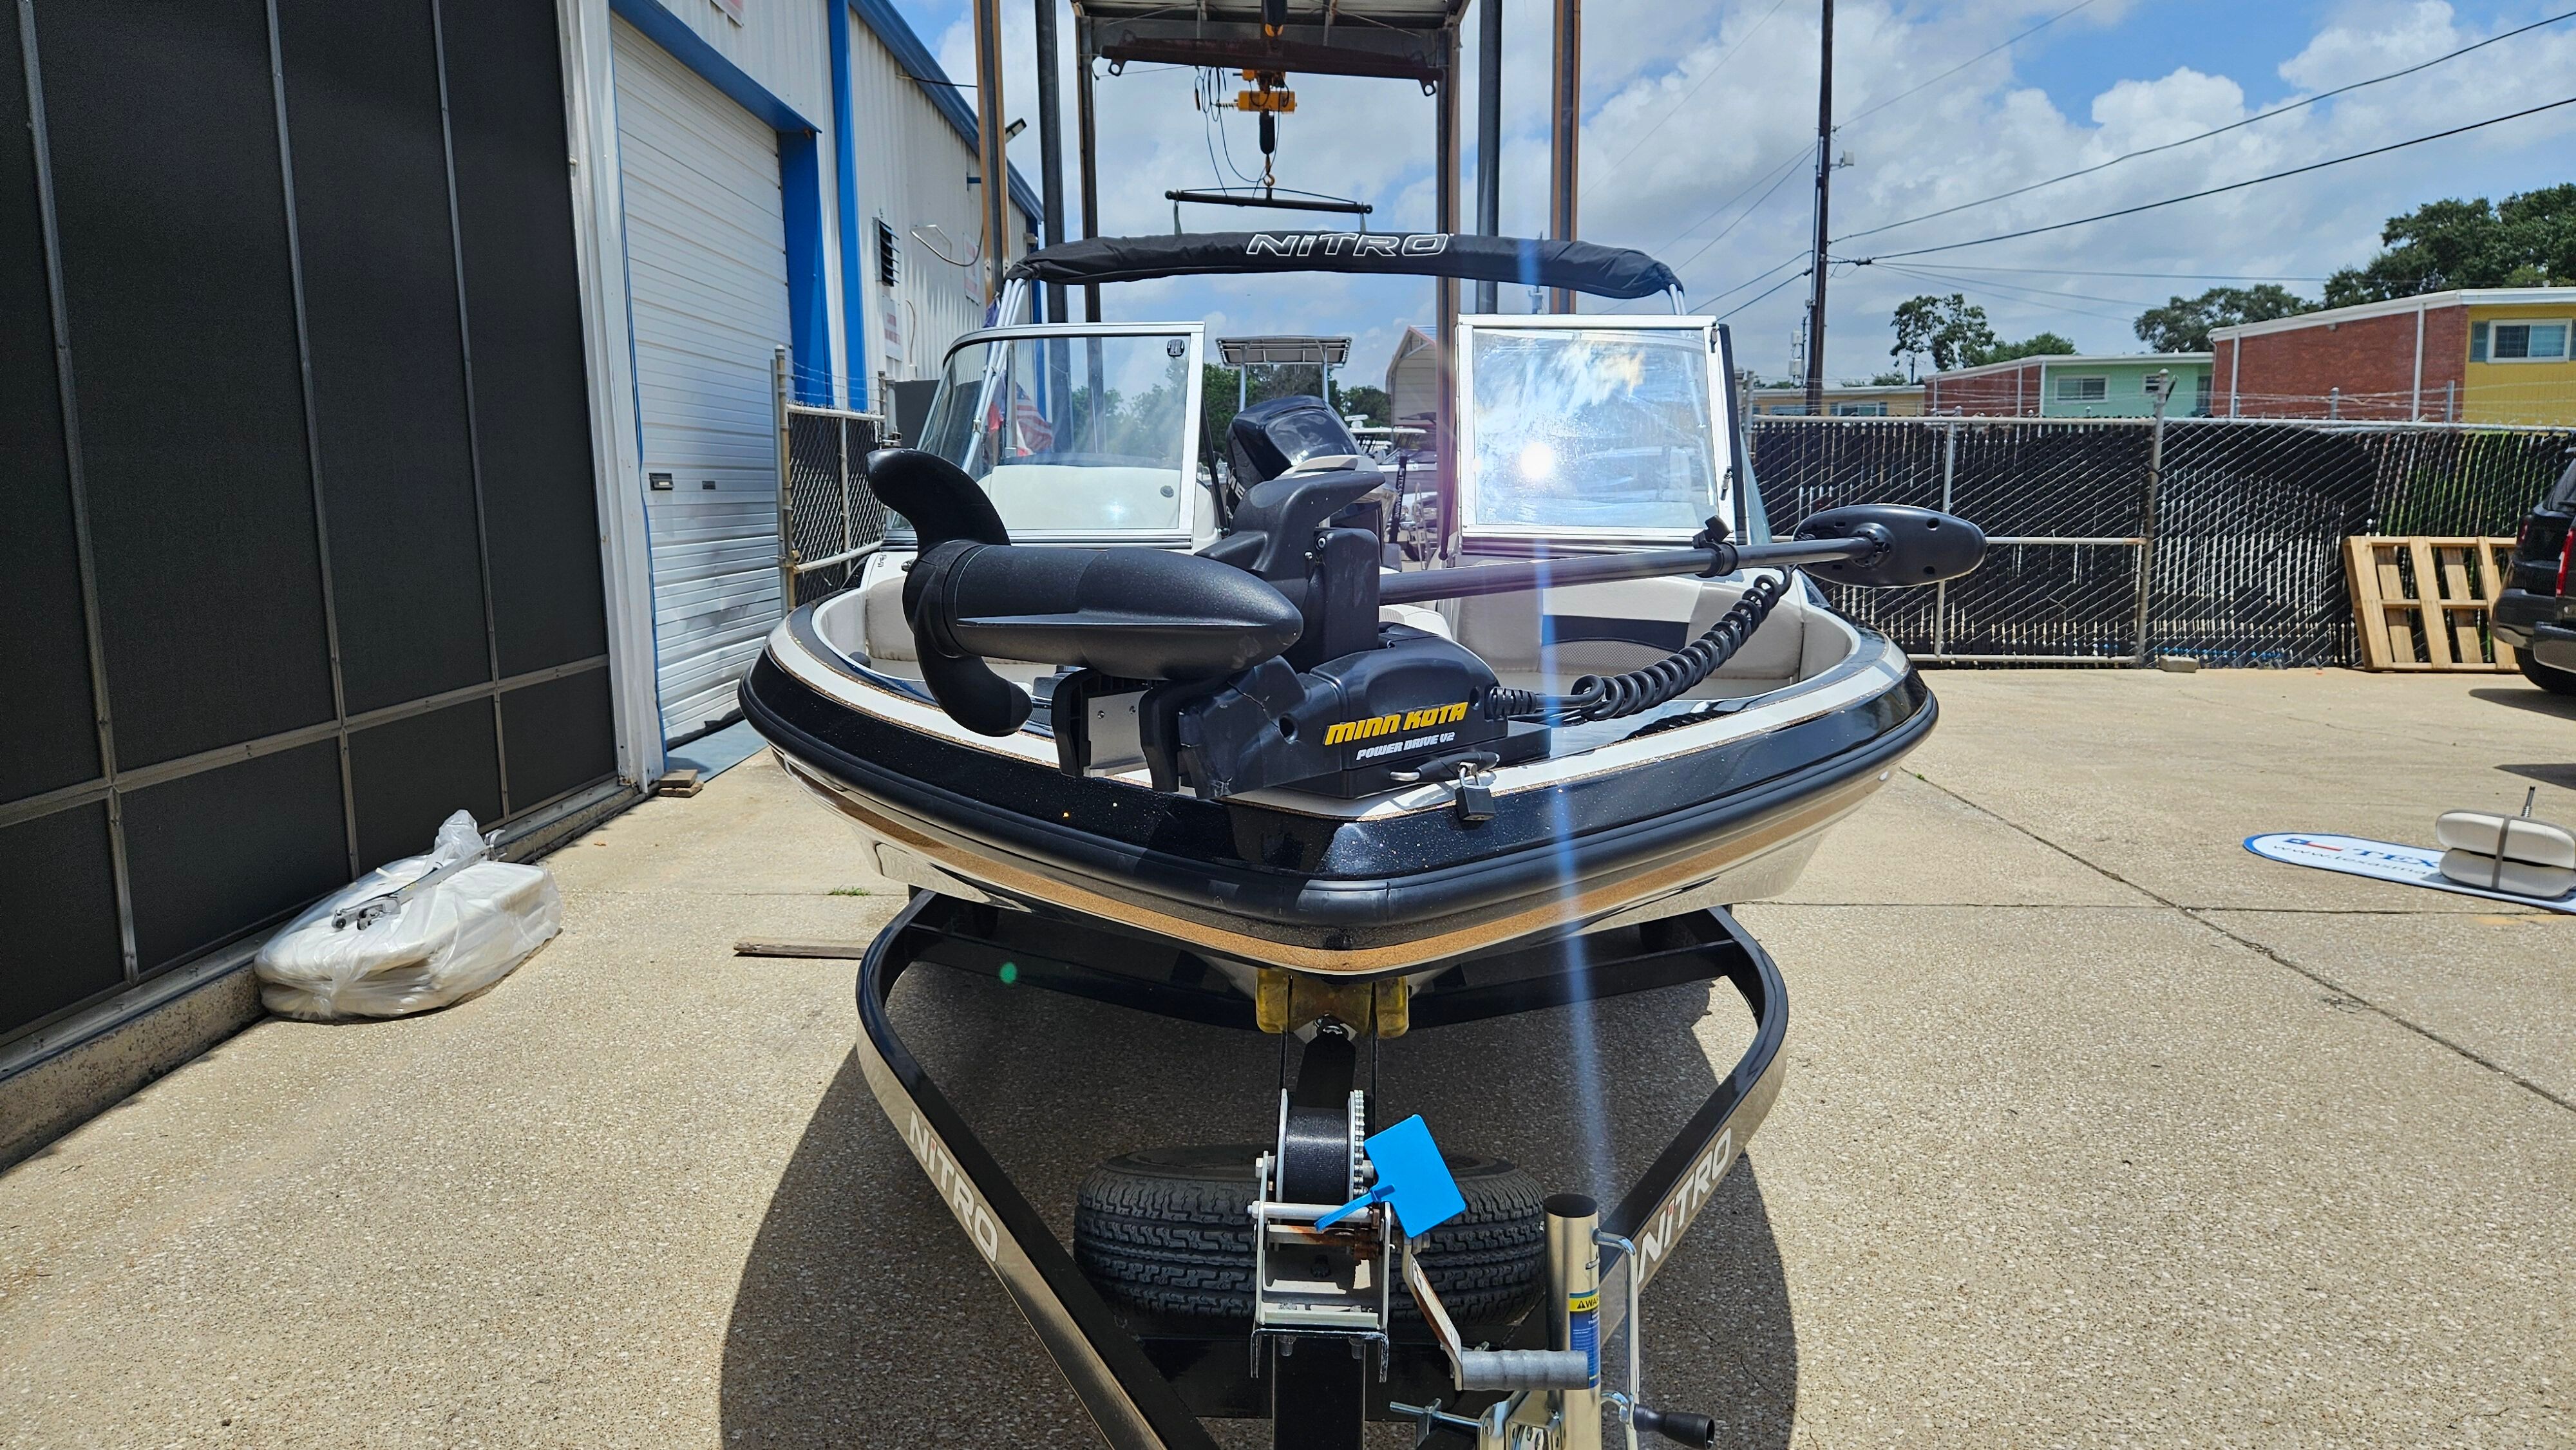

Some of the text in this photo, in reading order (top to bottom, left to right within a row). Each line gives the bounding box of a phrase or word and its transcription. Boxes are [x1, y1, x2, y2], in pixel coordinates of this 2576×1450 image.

[1246, 233, 1448, 256] NITRO
[1323, 702, 1468, 746] MINN KOTA
[1356, 731, 1455, 760] POWER DRIVE V2
[909, 1109, 998, 1262] NITRO
[1638, 1127, 1732, 1284] NITRO
